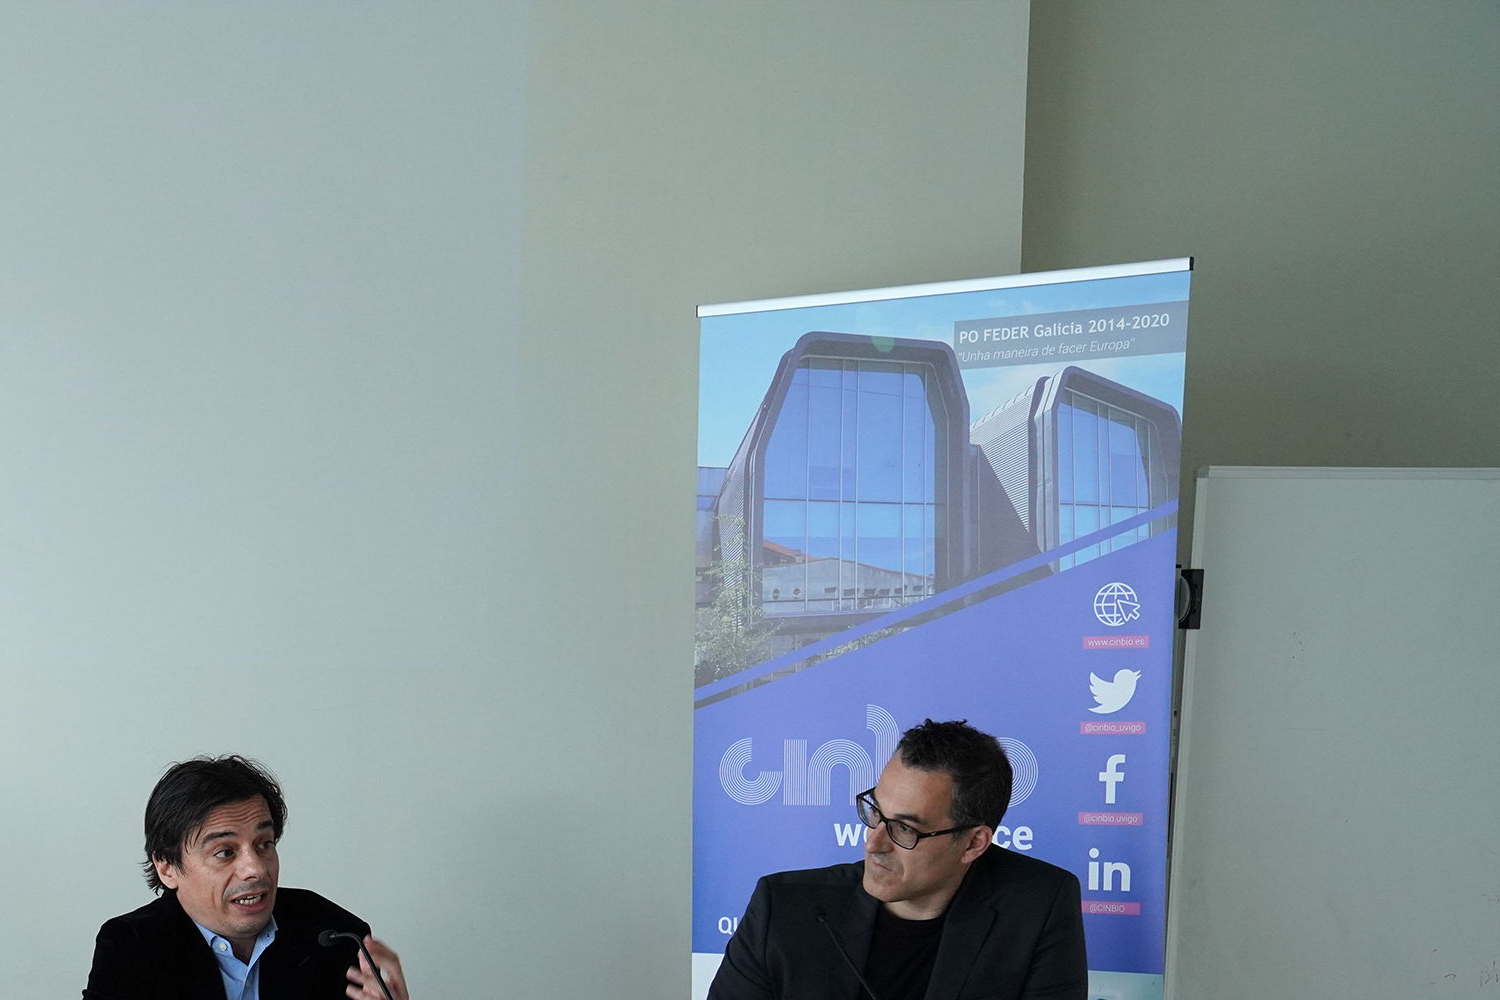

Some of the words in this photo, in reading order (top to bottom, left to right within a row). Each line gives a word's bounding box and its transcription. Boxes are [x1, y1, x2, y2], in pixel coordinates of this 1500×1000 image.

[960, 330, 979, 344] PO
[983, 326, 1029, 342] FEDER
[1034, 322, 1083, 338] Galicia
[1088, 313, 1170, 333] 2014-2020
[993, 346, 1039, 360] maneira
[1041, 344, 1055, 356] de
[1058, 343, 1086, 354] facer
[1088, 637, 1144, 646] www.cinbio.es
[1084, 723, 1141, 734] @cinbio_uvigo
[1083, 814, 1138, 825] @cinbio.uvigo
[1088, 848, 1130, 891] in
[1089, 903, 1125, 913] @CINBIO
